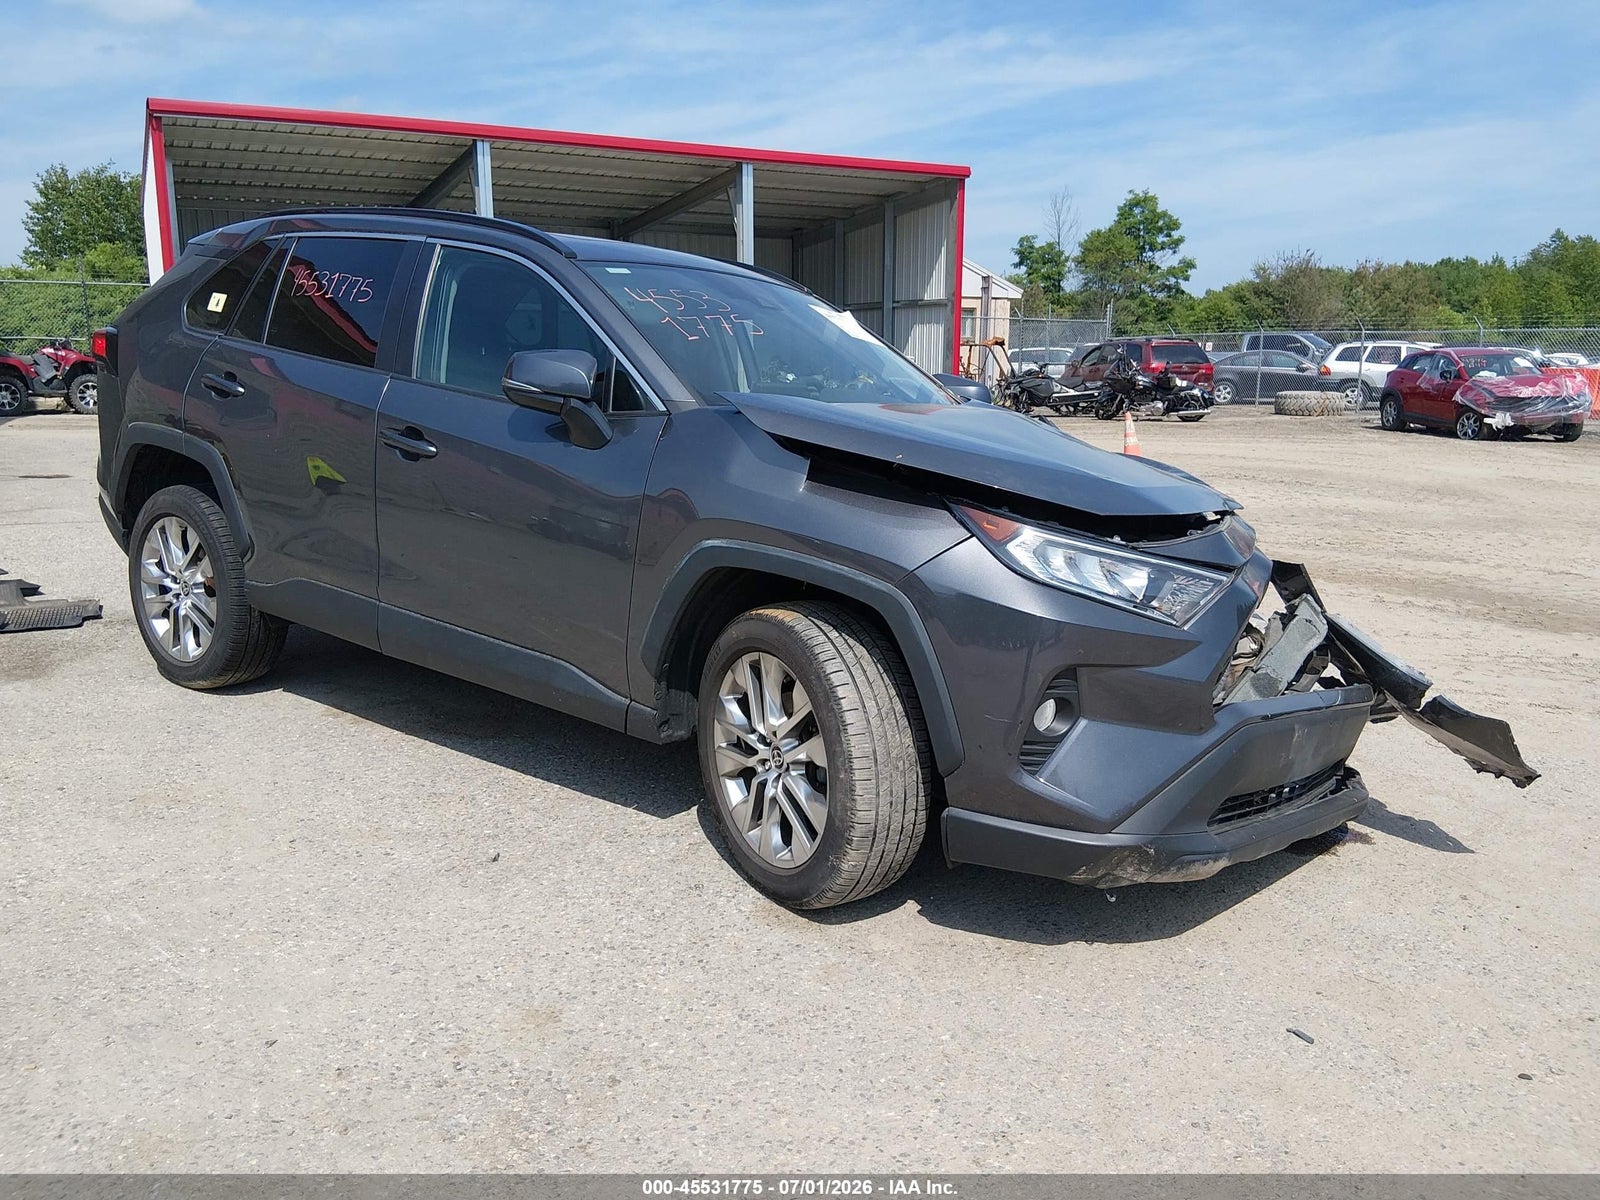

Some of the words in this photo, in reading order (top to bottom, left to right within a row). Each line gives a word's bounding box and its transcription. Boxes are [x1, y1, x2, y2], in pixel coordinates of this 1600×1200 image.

[291, 268, 374, 303] 45531775
[624, 287, 731, 314] 4553
[660, 313, 764, 341] 1775
